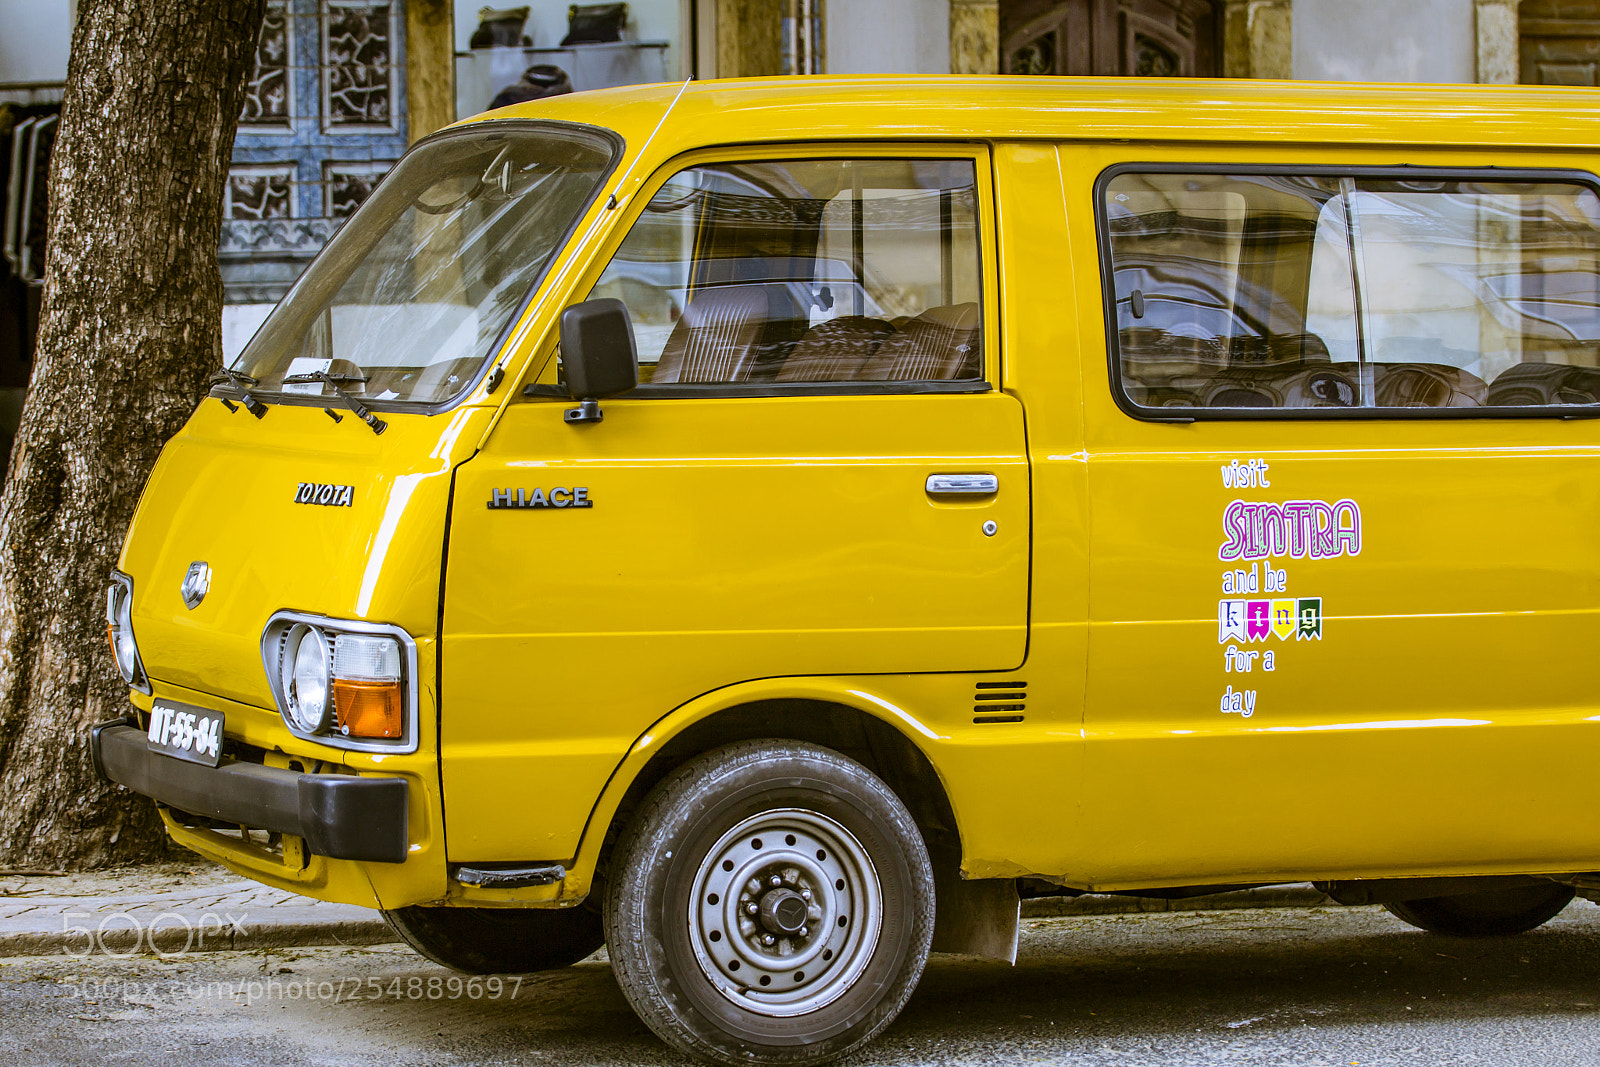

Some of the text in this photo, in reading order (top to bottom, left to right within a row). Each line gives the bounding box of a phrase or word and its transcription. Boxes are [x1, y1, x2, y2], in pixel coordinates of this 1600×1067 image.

[1222, 459, 1270, 488] visit
[294, 482, 355, 507] TOYOTA
[491, 486, 590, 508] HIACE
[1219, 499, 1361, 560] SINTRA
[1222, 561, 1287, 594] and be
[1223, 600, 1319, 634] king
[1224, 645, 1275, 673] for a
[1220, 685, 1257, 718] day
